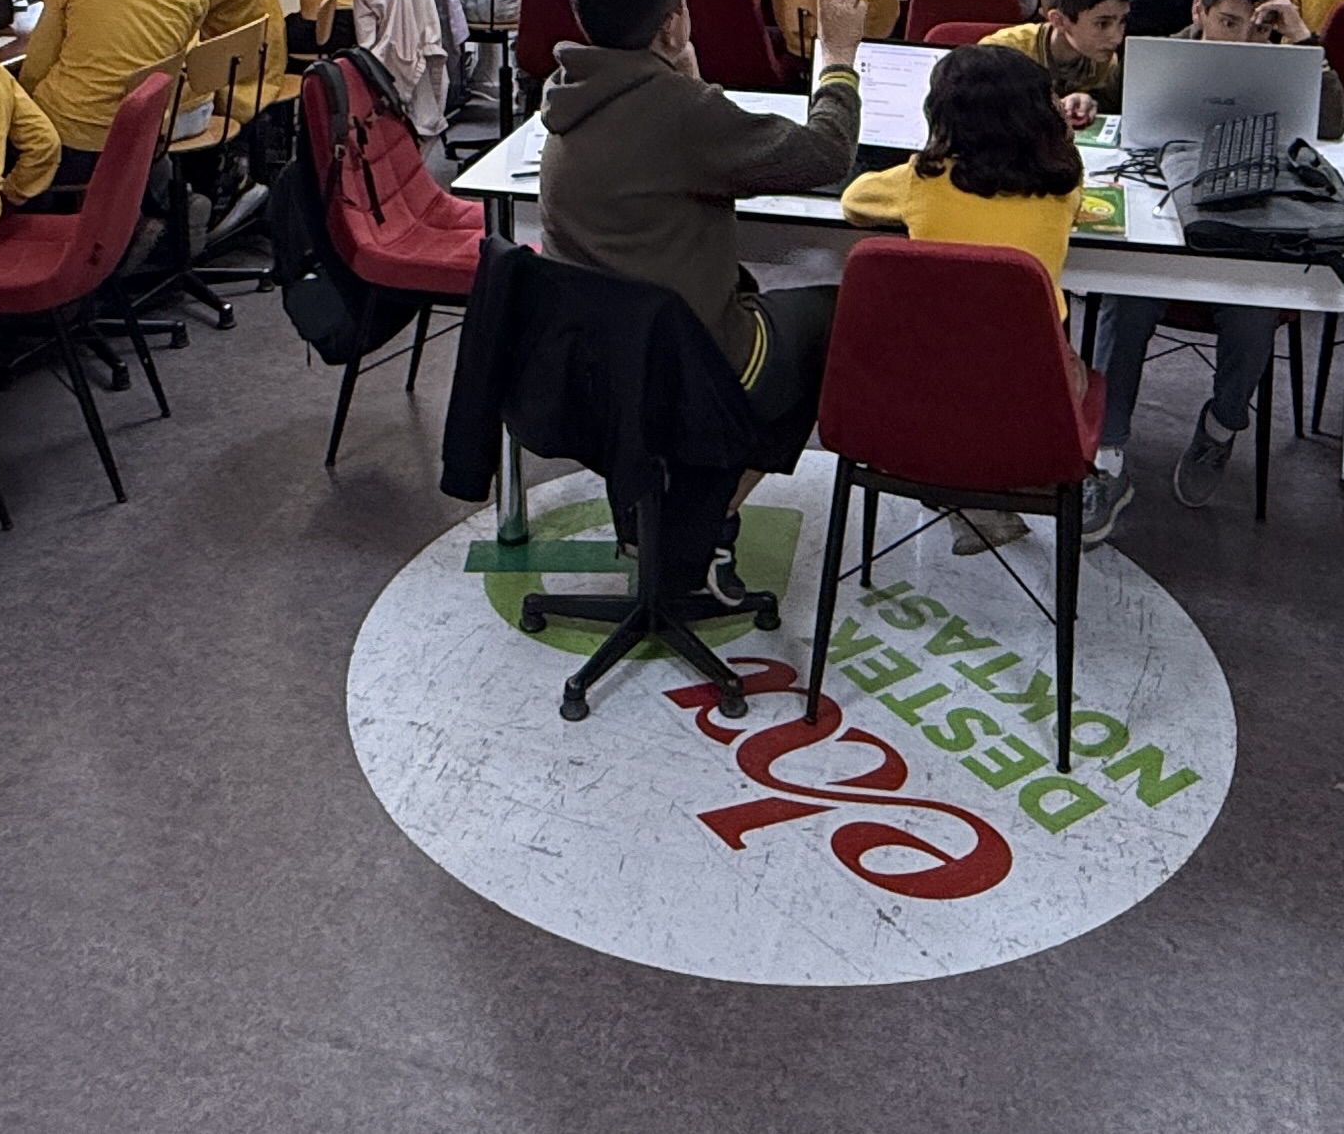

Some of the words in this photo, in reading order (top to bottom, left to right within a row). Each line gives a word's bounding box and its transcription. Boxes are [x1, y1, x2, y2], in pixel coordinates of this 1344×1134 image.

[662, 657, 1013, 900] eba
[800, 615, 1108, 835] DESTEK
[856, 580, 1203, 808] NOKTASI
